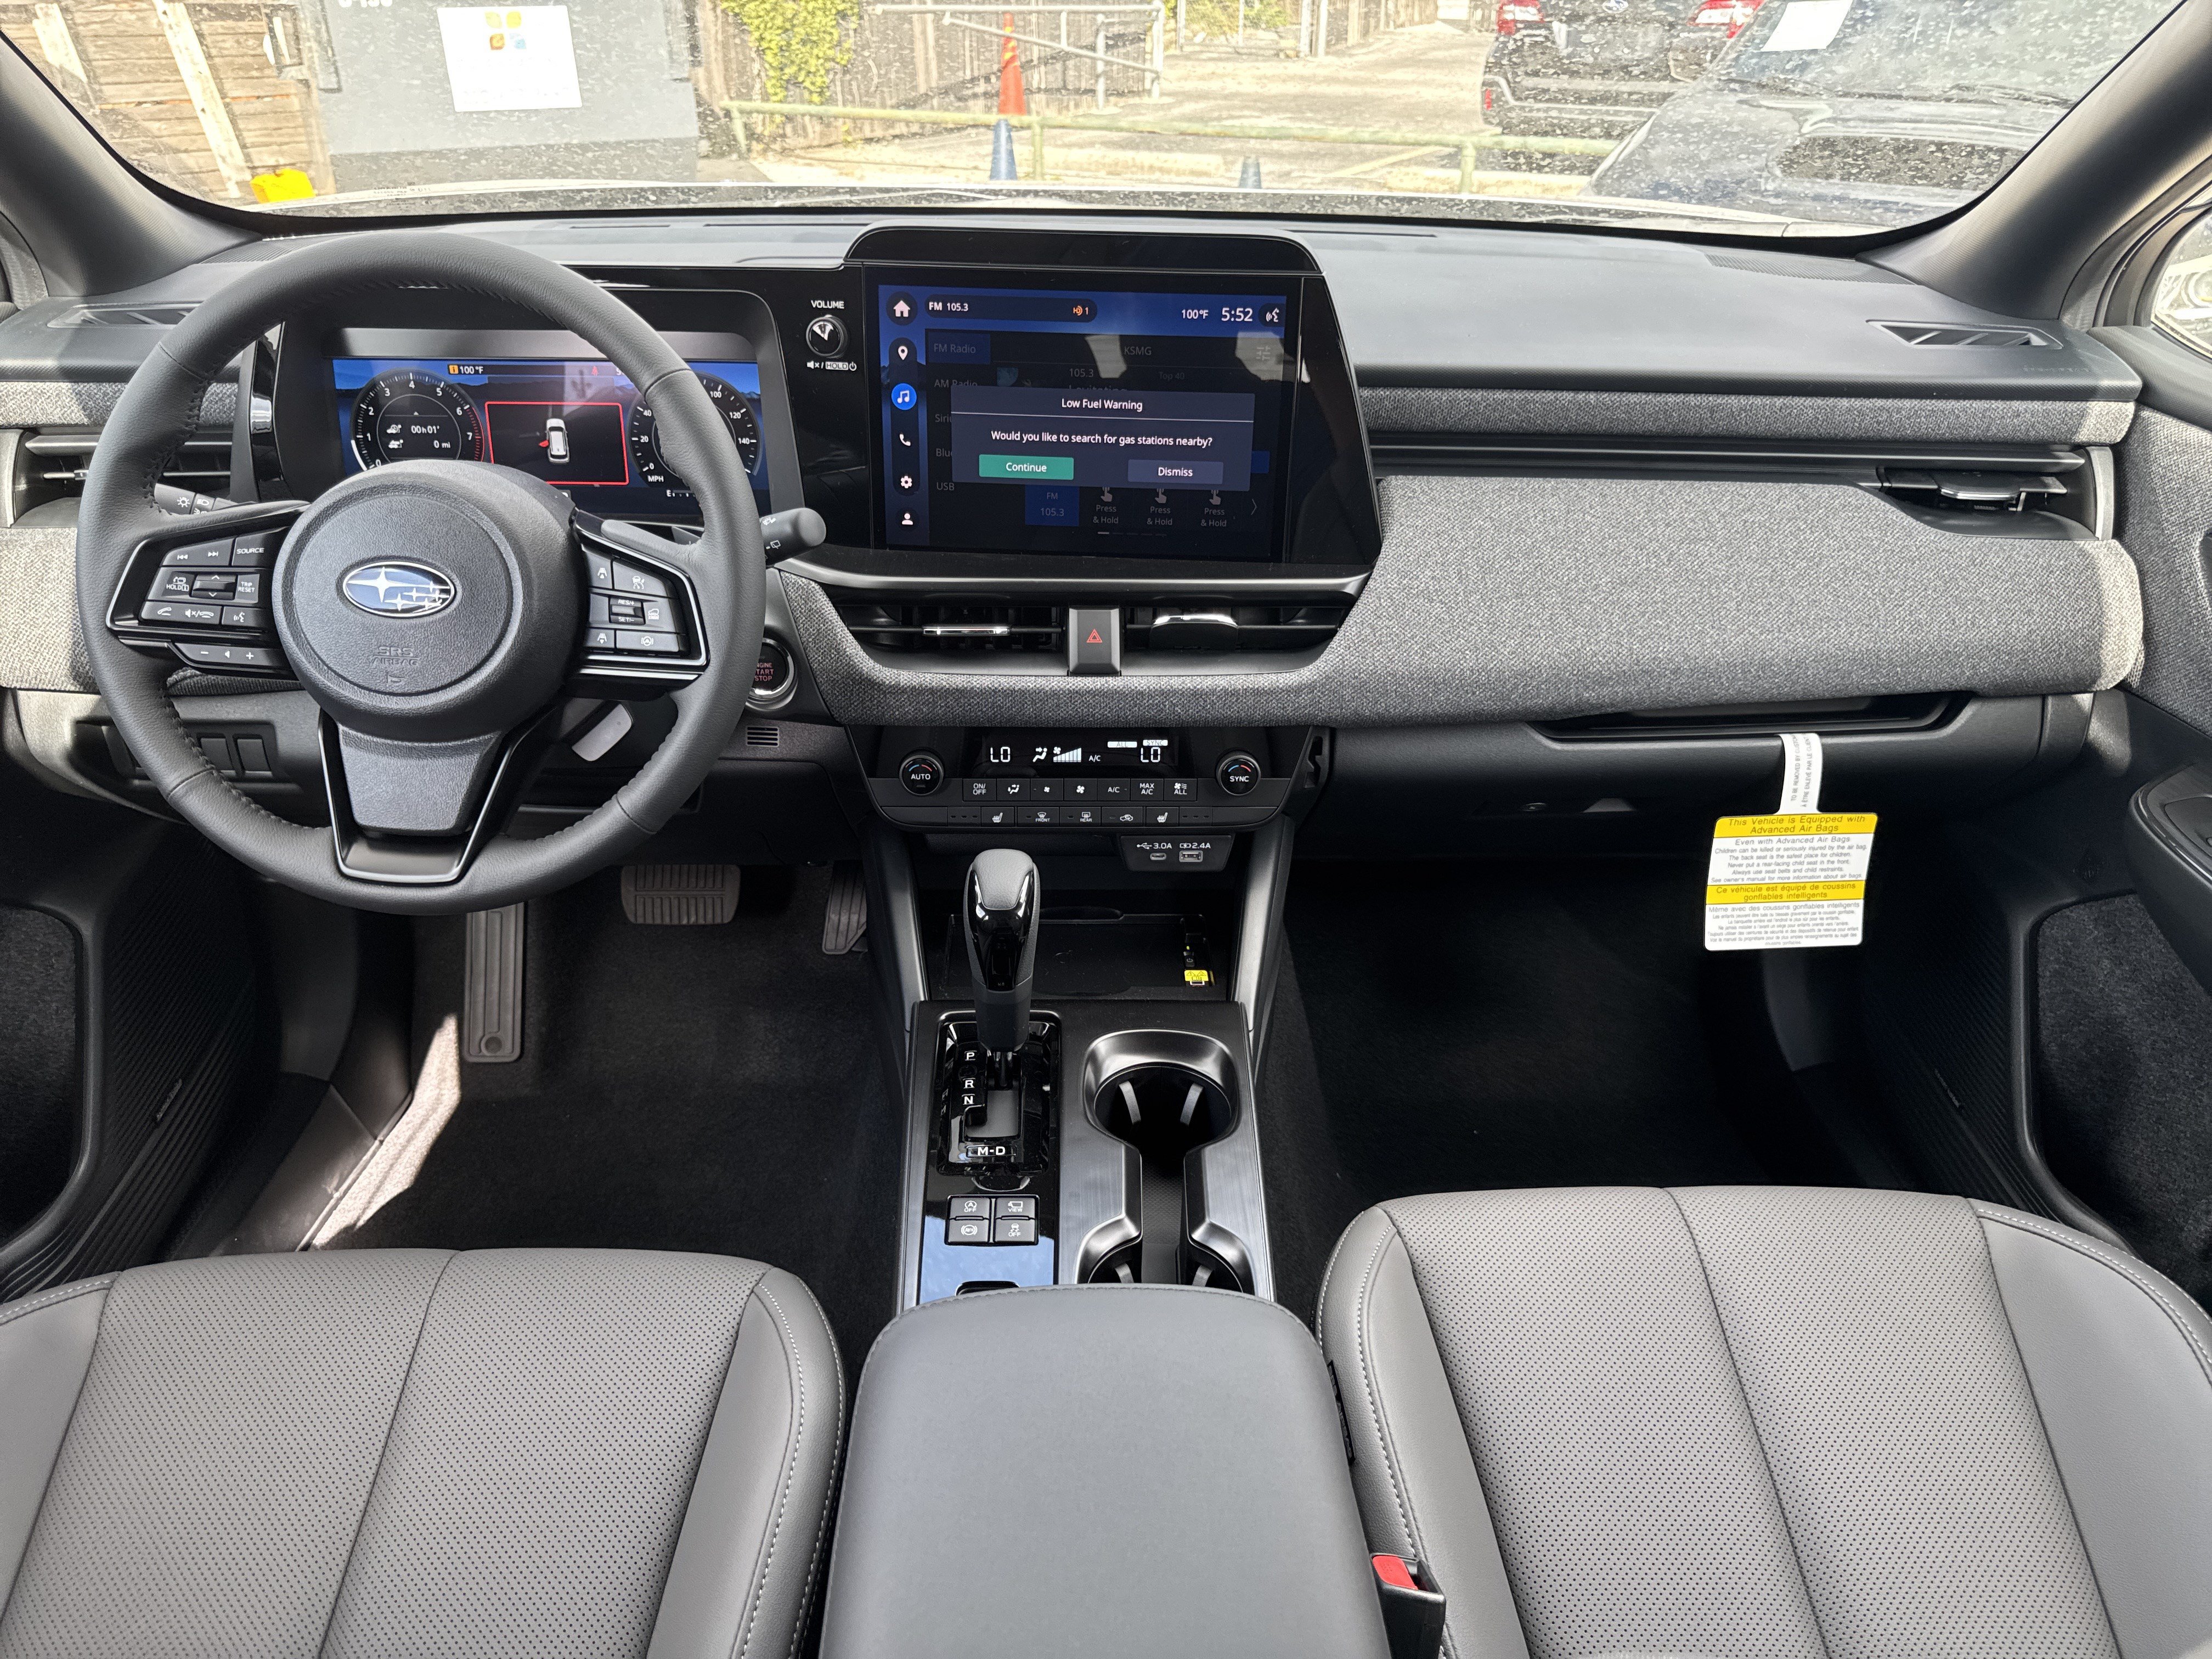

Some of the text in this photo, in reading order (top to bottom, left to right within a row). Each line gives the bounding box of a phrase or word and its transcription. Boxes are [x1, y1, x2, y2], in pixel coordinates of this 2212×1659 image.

[811, 300, 844, 309] VOLUME
[929, 302, 969, 312] FM 105.3
[1182, 309, 1209, 319] 100°F
[1221, 307, 1253, 321] 5:52
[934, 343, 976, 353] FM Radio
[1124, 346, 1152, 356] KSMG
[1069, 369, 1094, 377] 105.3
[1158, 371, 1173, 381] Top
[409, 381, 415, 389] 4
[934, 379, 949, 388] AM
[437, 388, 442, 396] 5
[1062, 398, 1143, 413] Low Fuel Warning
[369, 407, 374, 415] 2
[456, 407, 462, 415] 6
[466, 432, 473, 441] 7
[991, 431, 1212, 448] Would you like to search for gas stations nearby?
[433, 440, 439, 448] 0
[1006, 462, 1047, 472] Continue
[1158, 467, 1193, 477] Dismiss
[936, 482, 955, 490] USB
[1040, 508, 1064, 517] 105.3
[1150, 506, 1171, 515] Press
[1101, 516, 1119, 524] Hold
[1154, 517, 1173, 526] Hold
[378, 646, 414, 656] SRS
[1799, 815, 1843, 824] Equipped
[1750, 825, 1795, 834] Advanced
[1816, 824, 1839, 834] Bags
[1781, 884, 1807, 892] équipé
[1743, 892, 1827, 902] gonflables intelligents
[964, 1080, 974, 1088] R
[964, 1096, 973, 1104] N
